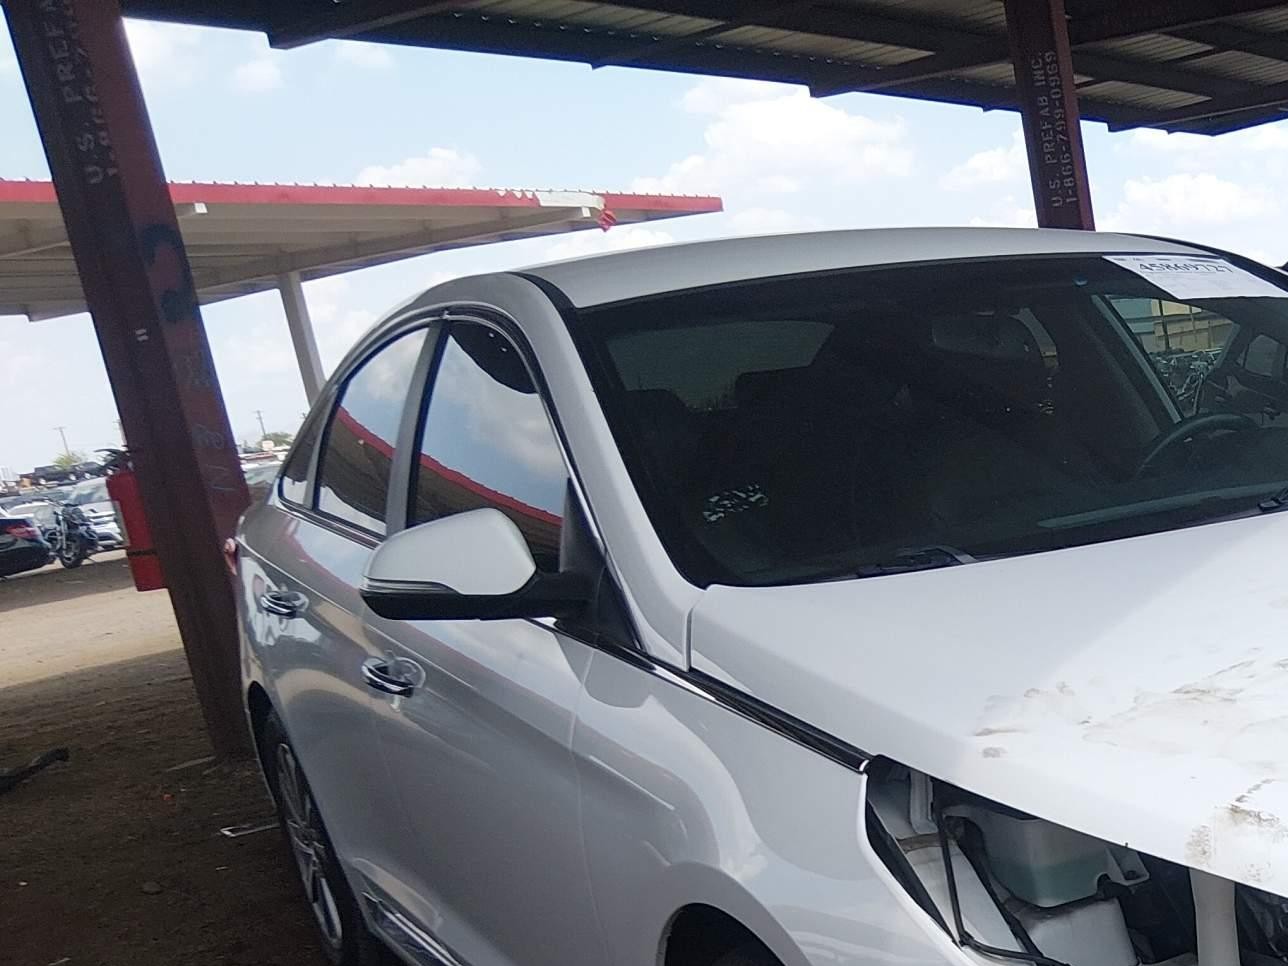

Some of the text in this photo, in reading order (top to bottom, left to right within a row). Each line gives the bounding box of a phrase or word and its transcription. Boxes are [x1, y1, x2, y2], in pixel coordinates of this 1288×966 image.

[1037, 95, 1058, 165] PREFAB
[1044, 50, 1078, 204] 1-866-799-0969
[1049, 173, 1064, 208] U.S.
